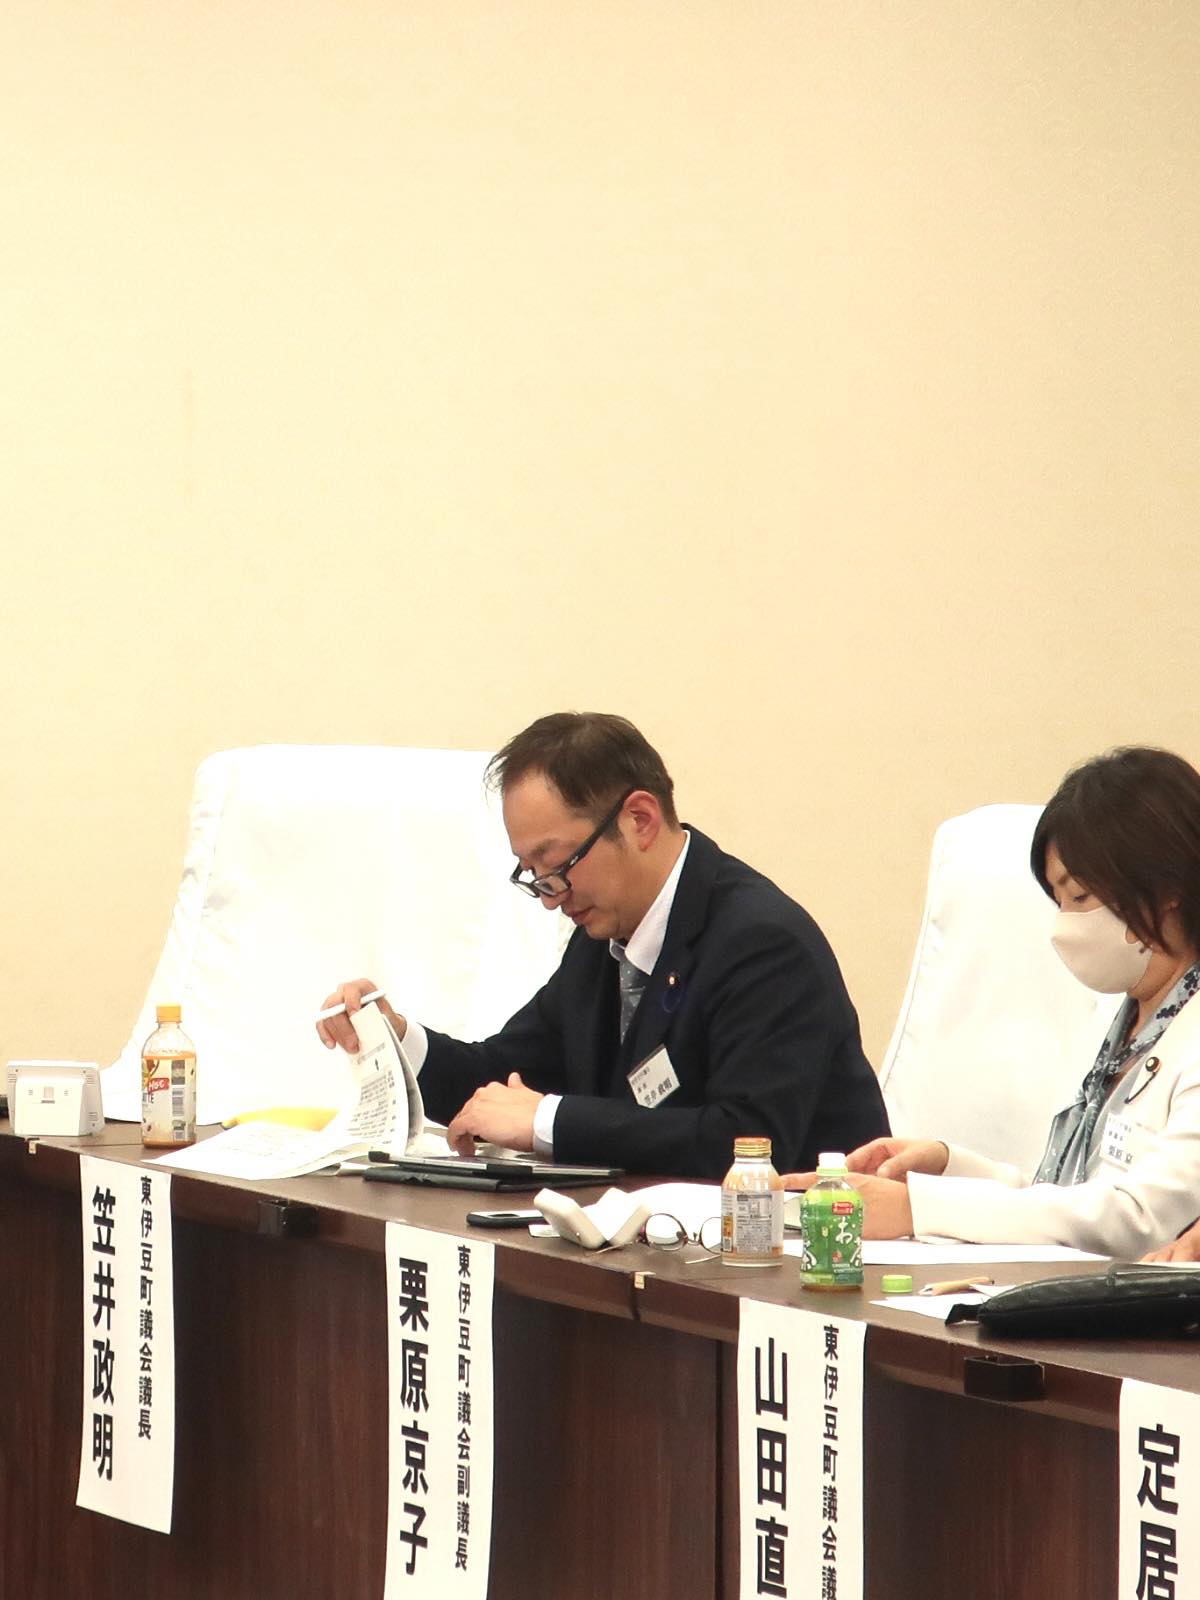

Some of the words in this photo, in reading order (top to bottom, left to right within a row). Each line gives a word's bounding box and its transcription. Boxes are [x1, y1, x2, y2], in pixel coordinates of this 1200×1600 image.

[92, 1185, 116, 1481] 笠井政明
[138, 1175, 153, 1440] 東伊豆町議会議長
[399, 1257, 430, 1576] 栗原京子
[455, 1244, 472, 1571] 東伊豆町議会副議長
[754, 1337, 789, 1599] 山田直
[1135, 1423, 1181, 1600] 定居
